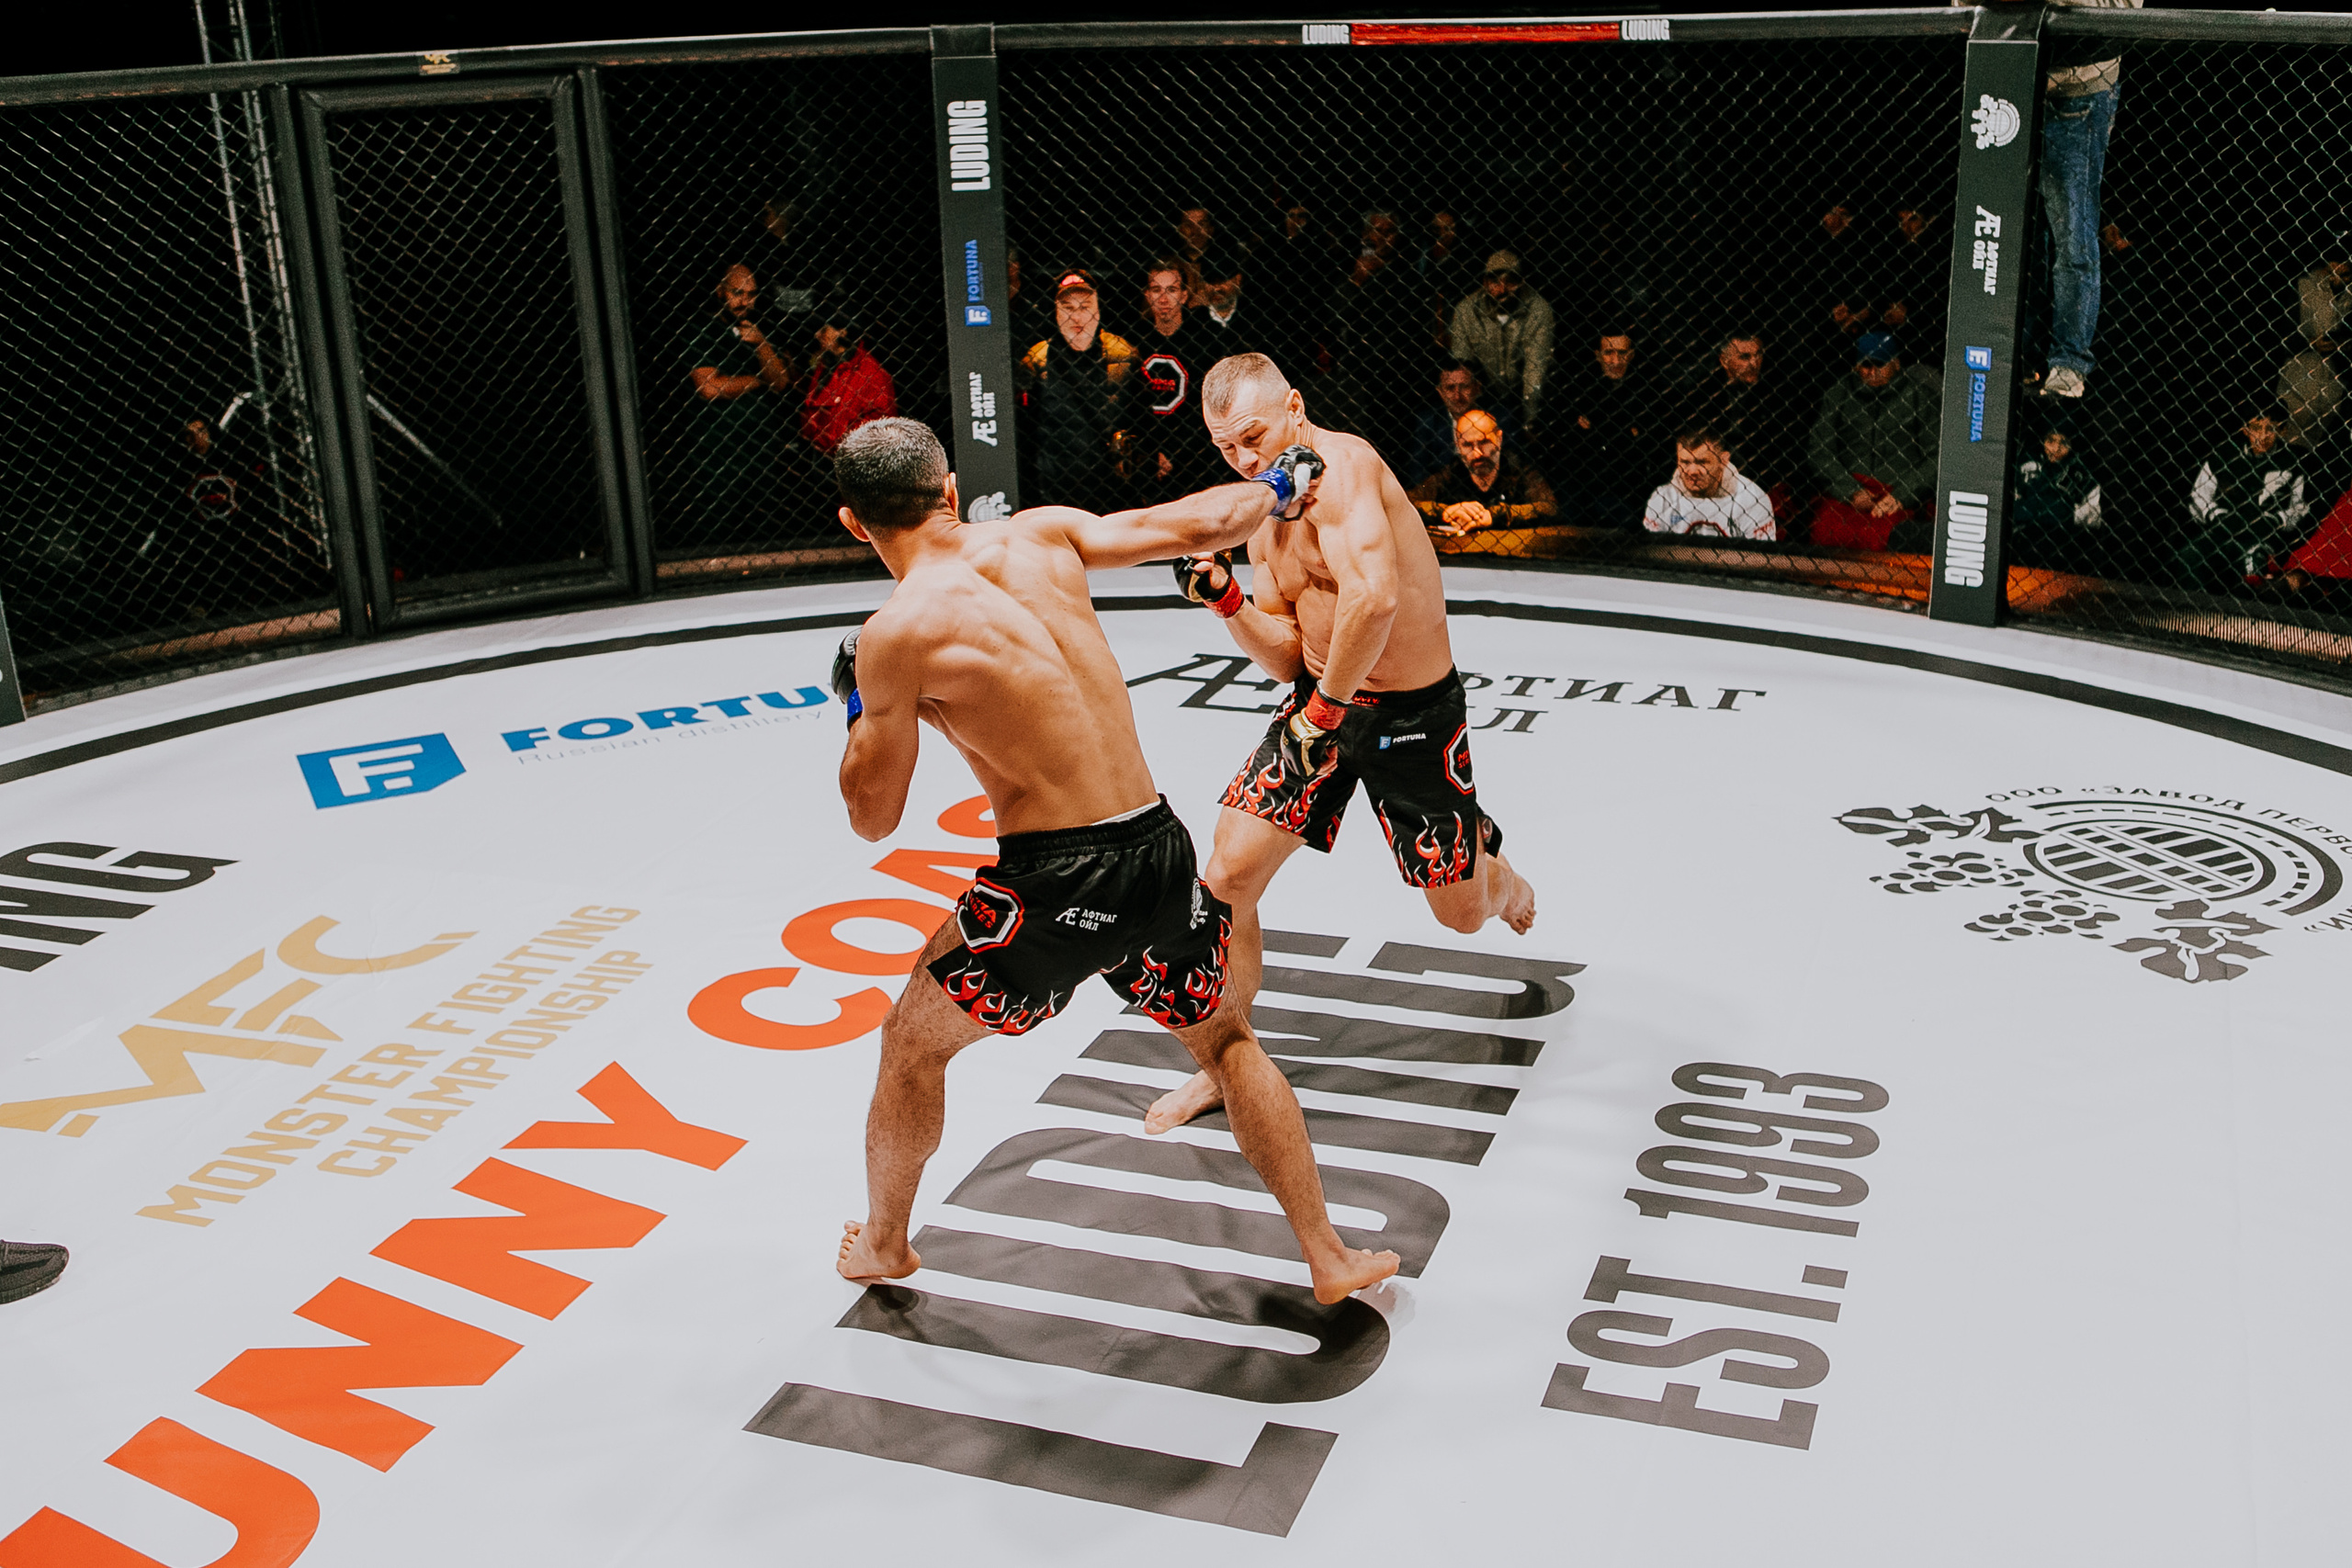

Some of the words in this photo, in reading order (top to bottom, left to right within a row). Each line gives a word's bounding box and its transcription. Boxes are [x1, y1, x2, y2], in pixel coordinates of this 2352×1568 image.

[1301, 24, 1350, 44] LUDING
[1622, 19, 1670, 41] LUDING
[947, 100, 990, 191] LUDING
[965, 239, 980, 303] FORTUNA
[1970, 373, 1986, 443] FORTUNA
[1945, 491, 1988, 588] LUDING
[500, 683, 831, 752] FORTU
[1459, 671, 1769, 712] ТИАГ
[518, 737, 662, 765] Russian
[677, 710, 825, 739] distillery
[1392, 733, 1427, 744] FORTUNA
[1985, 786, 2063, 803] ООО
[1079, 919, 1100, 931] ОЙЛ
[1081, 908, 1118, 923] АФТИАГ
[316, 951, 655, 1178] CHAMPIONSHIP
[134, 1043, 447, 1227] MONSTER
[1623, 1062, 1891, 1238] 1993
[741, 928, 1589, 1538] LUDING
[1540, 1255, 1848, 1450] EST.
